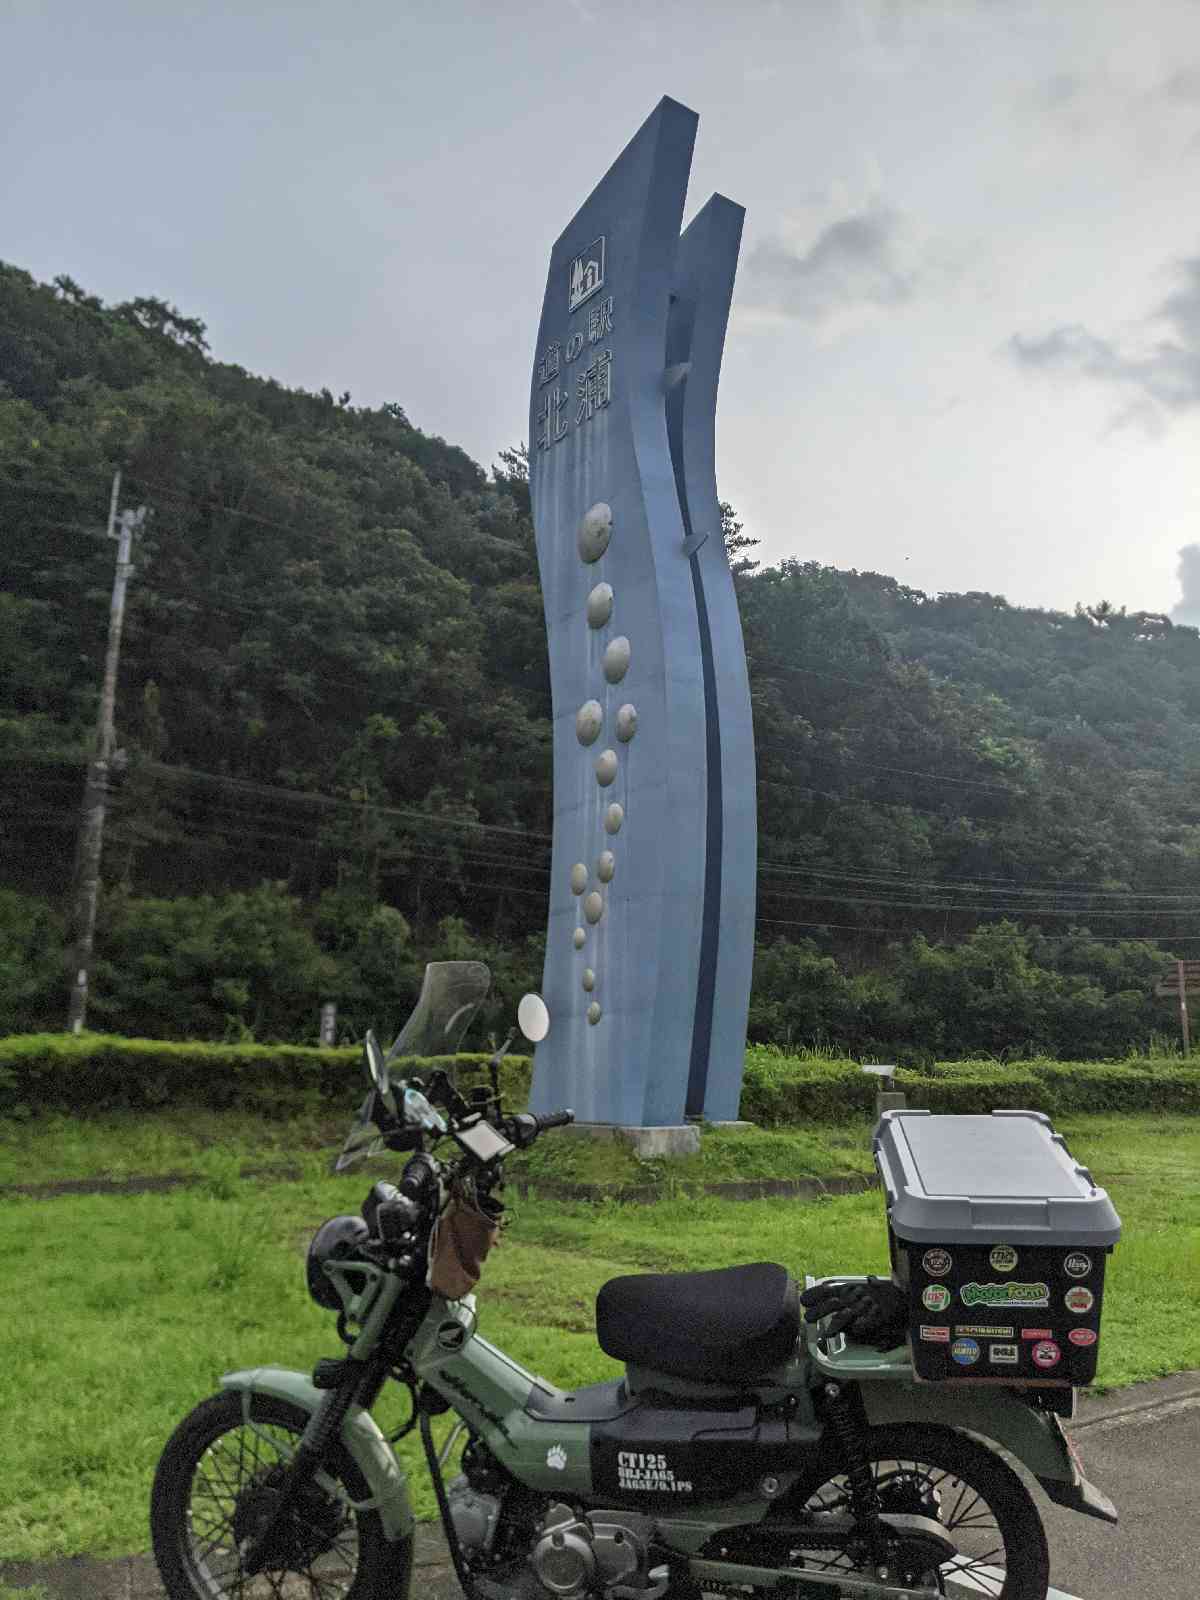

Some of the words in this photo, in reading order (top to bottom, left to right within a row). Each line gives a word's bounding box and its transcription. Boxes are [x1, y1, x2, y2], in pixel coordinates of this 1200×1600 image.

[537, 296, 614, 388] 道の駅
[536, 349, 613, 450] 北浦
[618, 1451, 667, 1469] CT125
